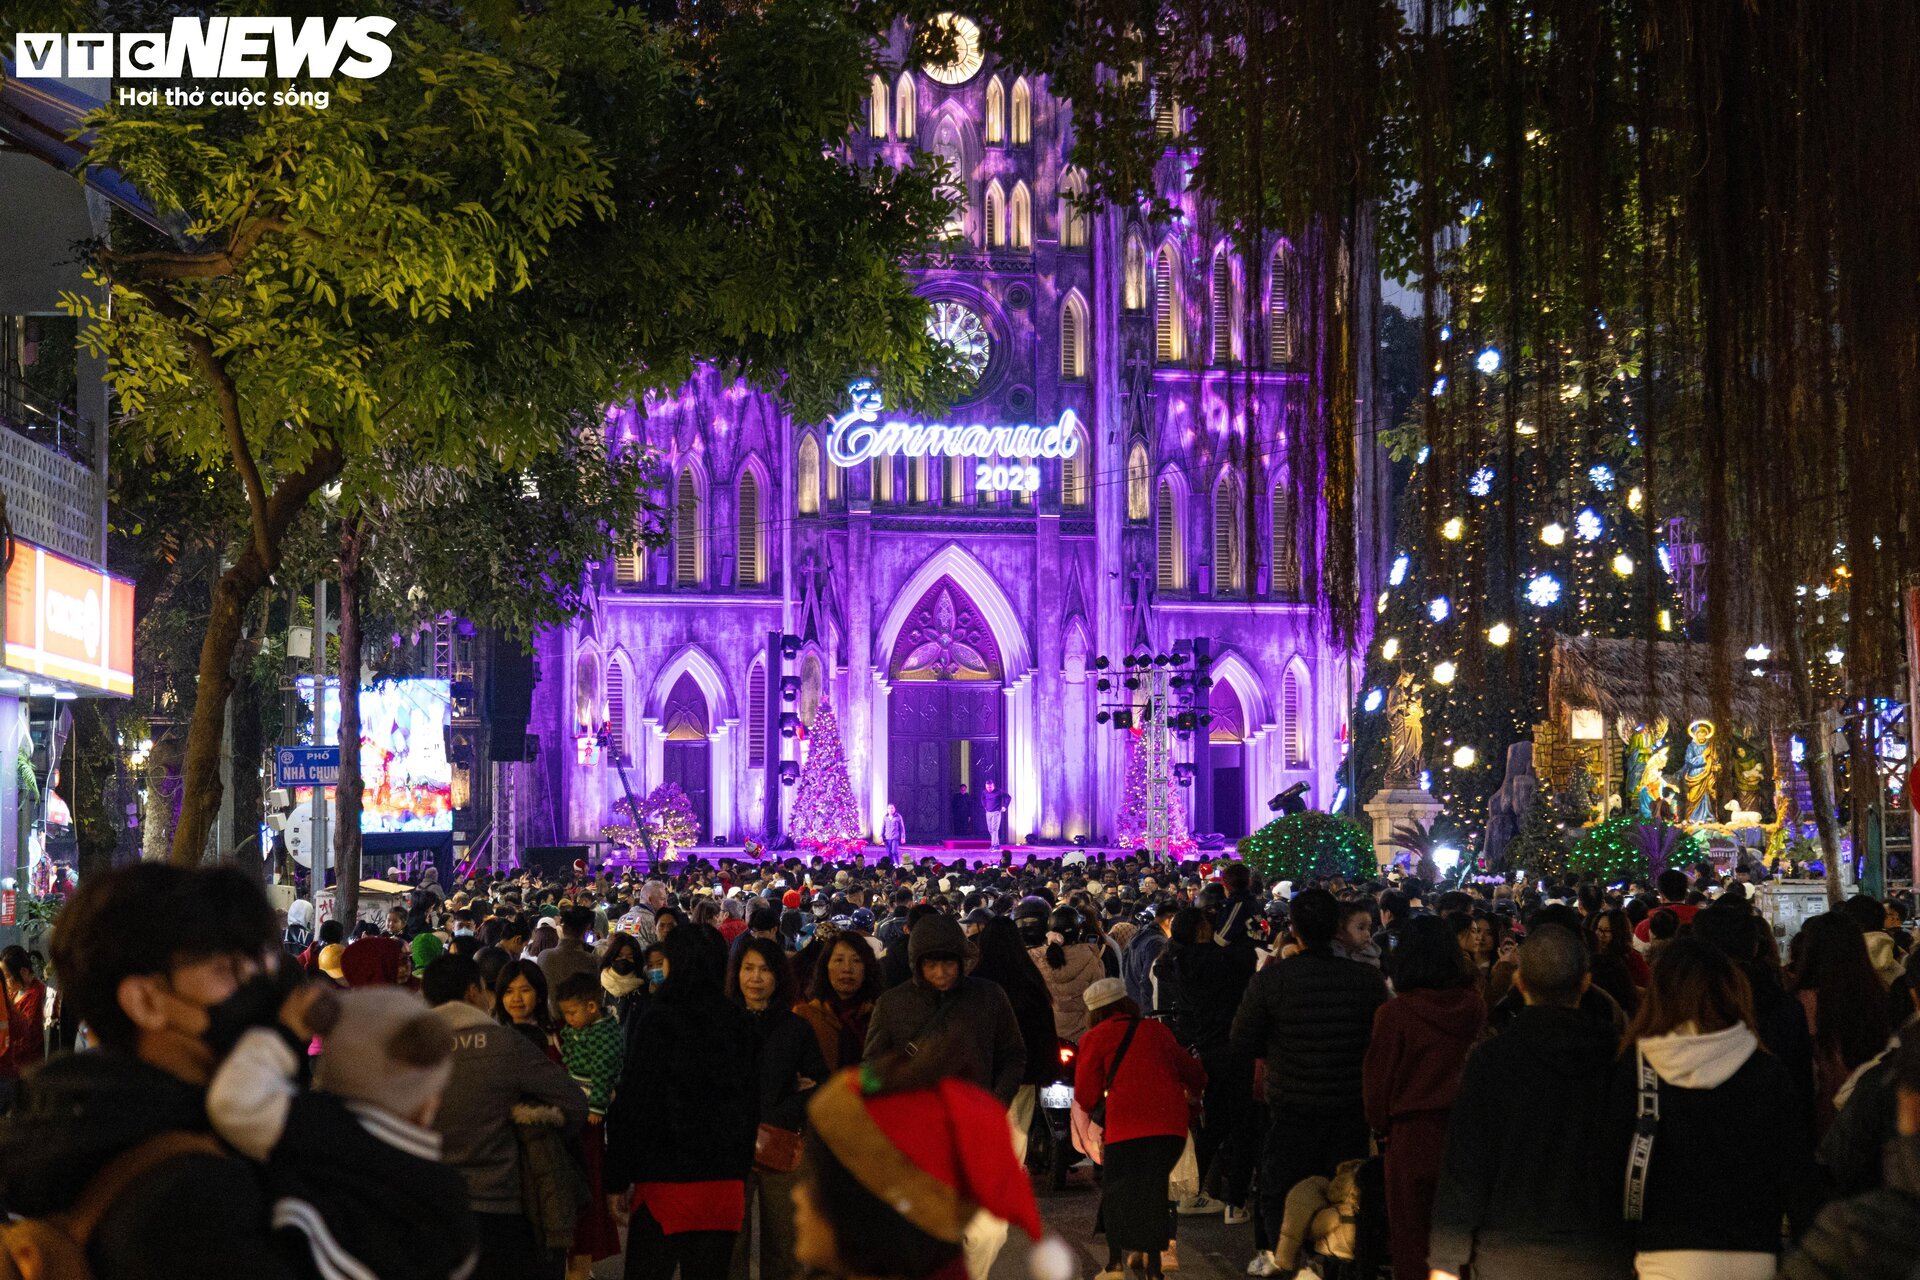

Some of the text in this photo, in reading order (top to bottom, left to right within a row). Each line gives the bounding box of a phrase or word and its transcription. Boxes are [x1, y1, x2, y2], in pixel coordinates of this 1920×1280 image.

[827, 409, 1079, 468] Emmanuel
[975, 465, 1040, 491] 2023
[306, 749, 330, 760] PHỐ
[283, 763, 339, 780] NHÀ CHUN
[1633, 1136, 1650, 1168] MLB
